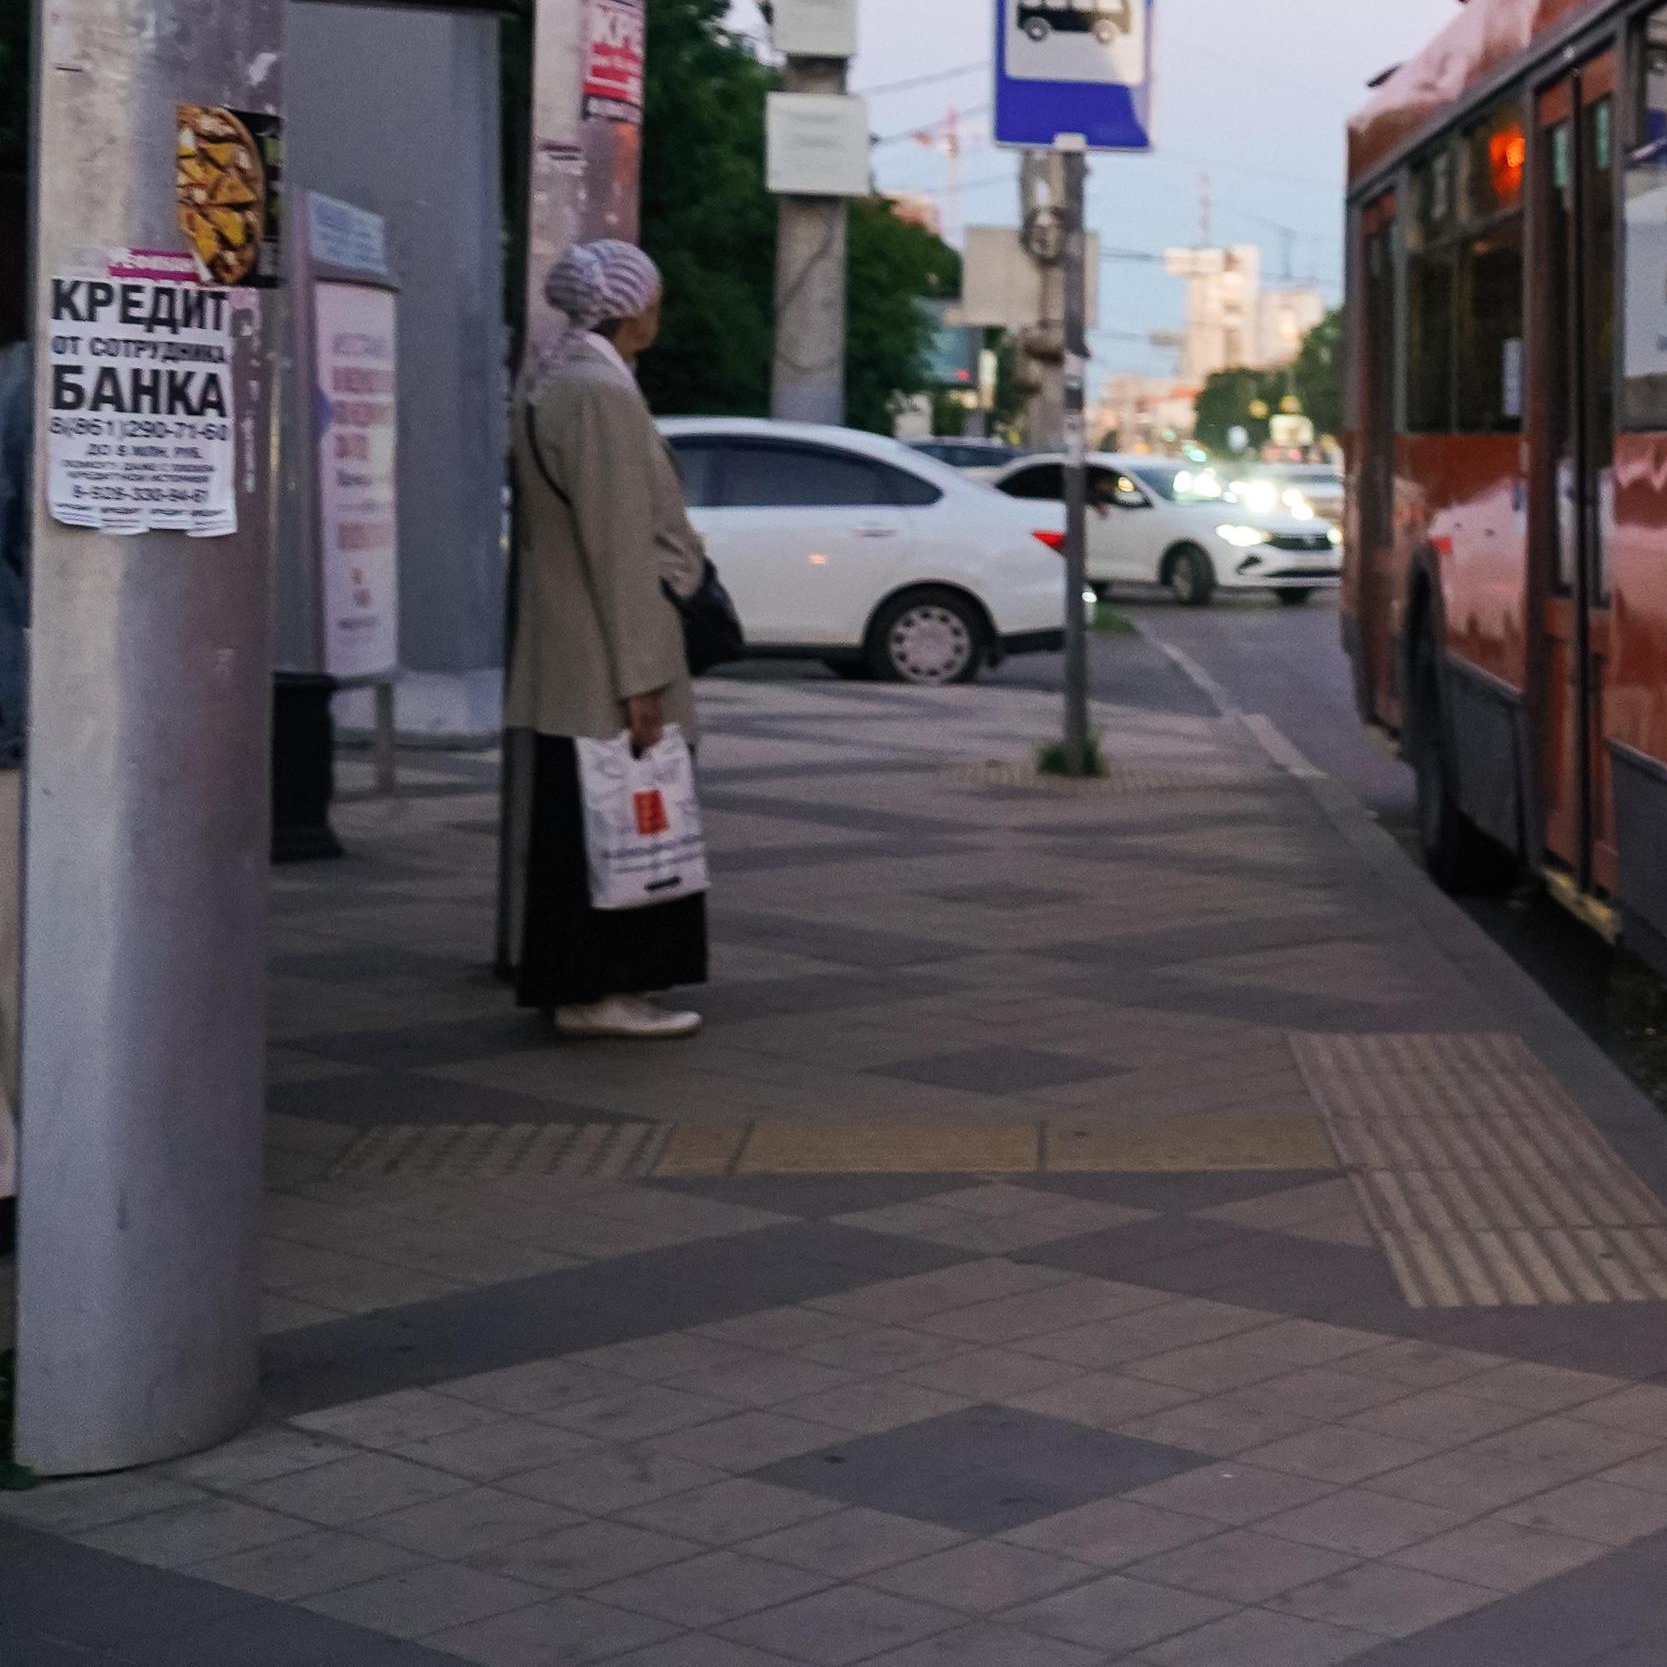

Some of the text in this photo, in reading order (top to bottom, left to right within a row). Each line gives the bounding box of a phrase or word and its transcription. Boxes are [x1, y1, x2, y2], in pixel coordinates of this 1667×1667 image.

[51, 279, 229, 334] КРЕДИТ
[52, 335, 81, 355] ОТ
[51, 364, 227, 417] БАНКА
